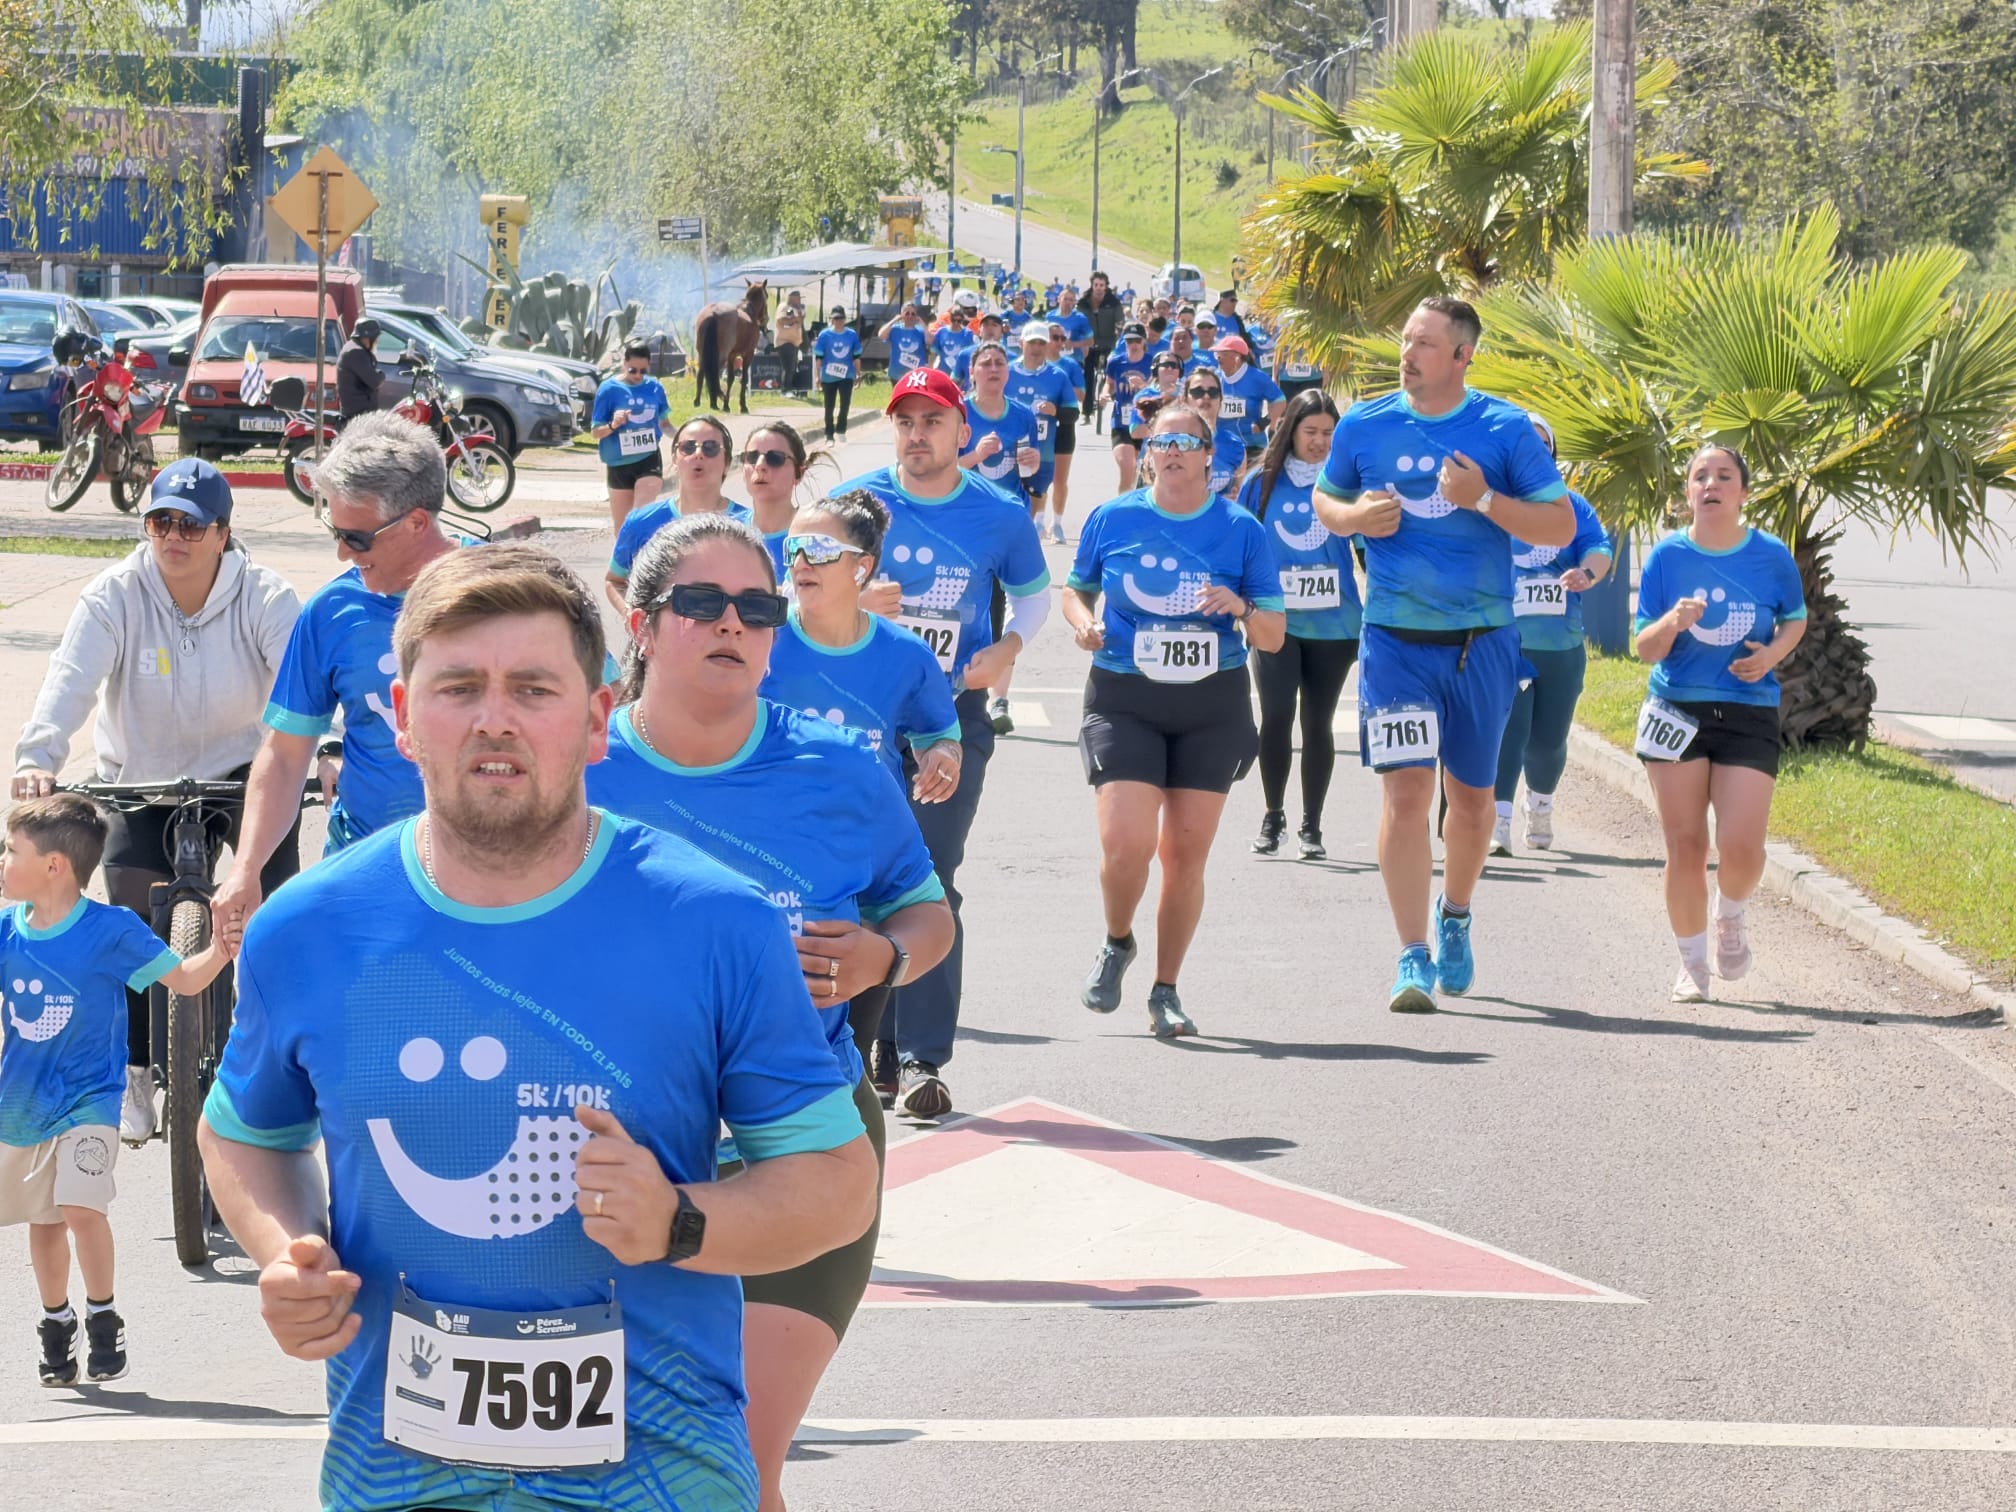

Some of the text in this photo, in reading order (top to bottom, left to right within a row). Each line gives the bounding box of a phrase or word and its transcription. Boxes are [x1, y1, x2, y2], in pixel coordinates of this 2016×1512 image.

[494, 206, 508, 326] FEREER
[906, 371, 928, 388] NY
[1297, 576, 1336, 597] 7244
[1524, 584, 1563, 604] 7252
[1160, 640, 1211, 667] 7831
[1381, 719, 1429, 748] 7161
[1641, 713, 1687, 751] 7160
[743, 842, 758, 855] EN
[757, 849, 784, 870] TODO
[783, 866, 793, 878] EL
[443, 947, 482, 979] Juntos
[481, 976, 511, 998] más
[511, 991, 543, 1015] lejos
[541, 1009, 560, 1026] EN
[559, 1021, 594, 1052] TODO
[591, 1049, 606, 1066] EL
[452, 1313, 470, 1324] AAU
[536, 1317, 563, 1326] Pérez
[536, 1322, 577, 1334] Scremini
[452, 1355, 614, 1431] 7592
